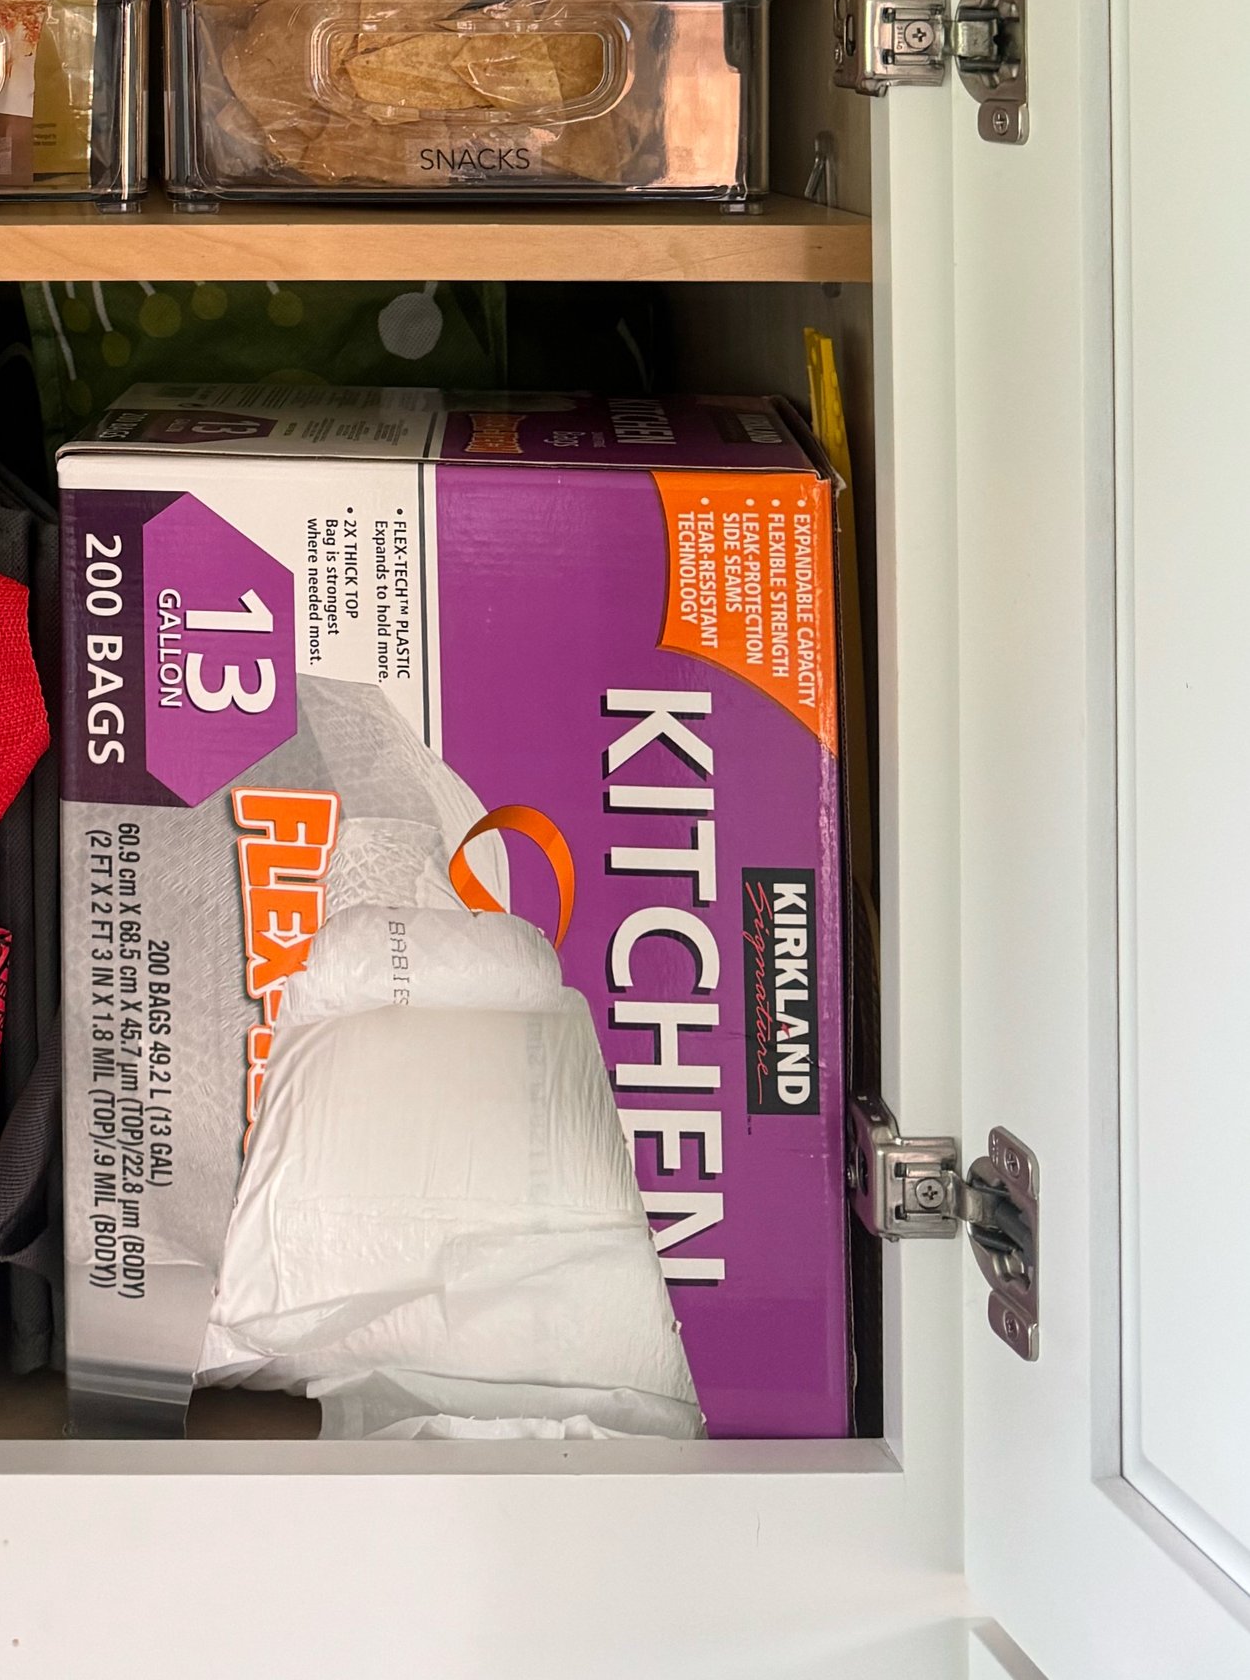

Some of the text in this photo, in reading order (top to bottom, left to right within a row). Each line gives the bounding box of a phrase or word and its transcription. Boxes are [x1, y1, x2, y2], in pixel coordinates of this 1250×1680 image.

[419, 147, 531, 172] SNACKS
[192, 420, 261, 435] 13
[307, 518, 323, 666] where needed most.
[323, 519, 339, 635] Bag is strongest
[344, 519, 359, 619] 2X THICK TOP
[372, 521, 391, 683] Expands to hold more.
[677, 511, 698, 624] TECHNOLOGY
[697, 511, 718, 649] TEAR-RESISTANT
[722, 512, 743, 613] SIDE SEAMS
[742, 513, 764, 665] LEAK-PROTECTION
[768, 513, 790, 678] FLEXIBLE STRENGTH
[793, 513, 817, 709] EXPANDABLE CAPACITY
[85, 533, 126, 764] 200 BAGS
[158, 588, 183, 708] GALLON
[185, 587, 277, 714] 13
[395, 620, 410, 679] PLASTIC
[118, 823, 141, 864] 60.9
[118, 868, 137, 897] cm
[119, 902, 142, 916] X
[119, 920, 142, 961] 68.5
[119, 965, 138, 994] cm
[120, 999, 143, 1013] X
[604, 688, 726, 1283] KITCHEN
[741, 881, 774, 1106] Signature
[773, 882, 811, 1106] KIRKLAND
[85, 829, 117, 1289] (2 FT X 2 FT 3 IN X 1.8 MIL (TOP)/.9 MIL (BODY))
[120, 1017, 143, 1058] 45.7
[144, 940, 173, 1187] 200 BAGS 49.2 L (13 GAL)
[117, 1097, 144, 1194] (TOP)/22.8
[117, 1234, 145, 1299] (BODY)
